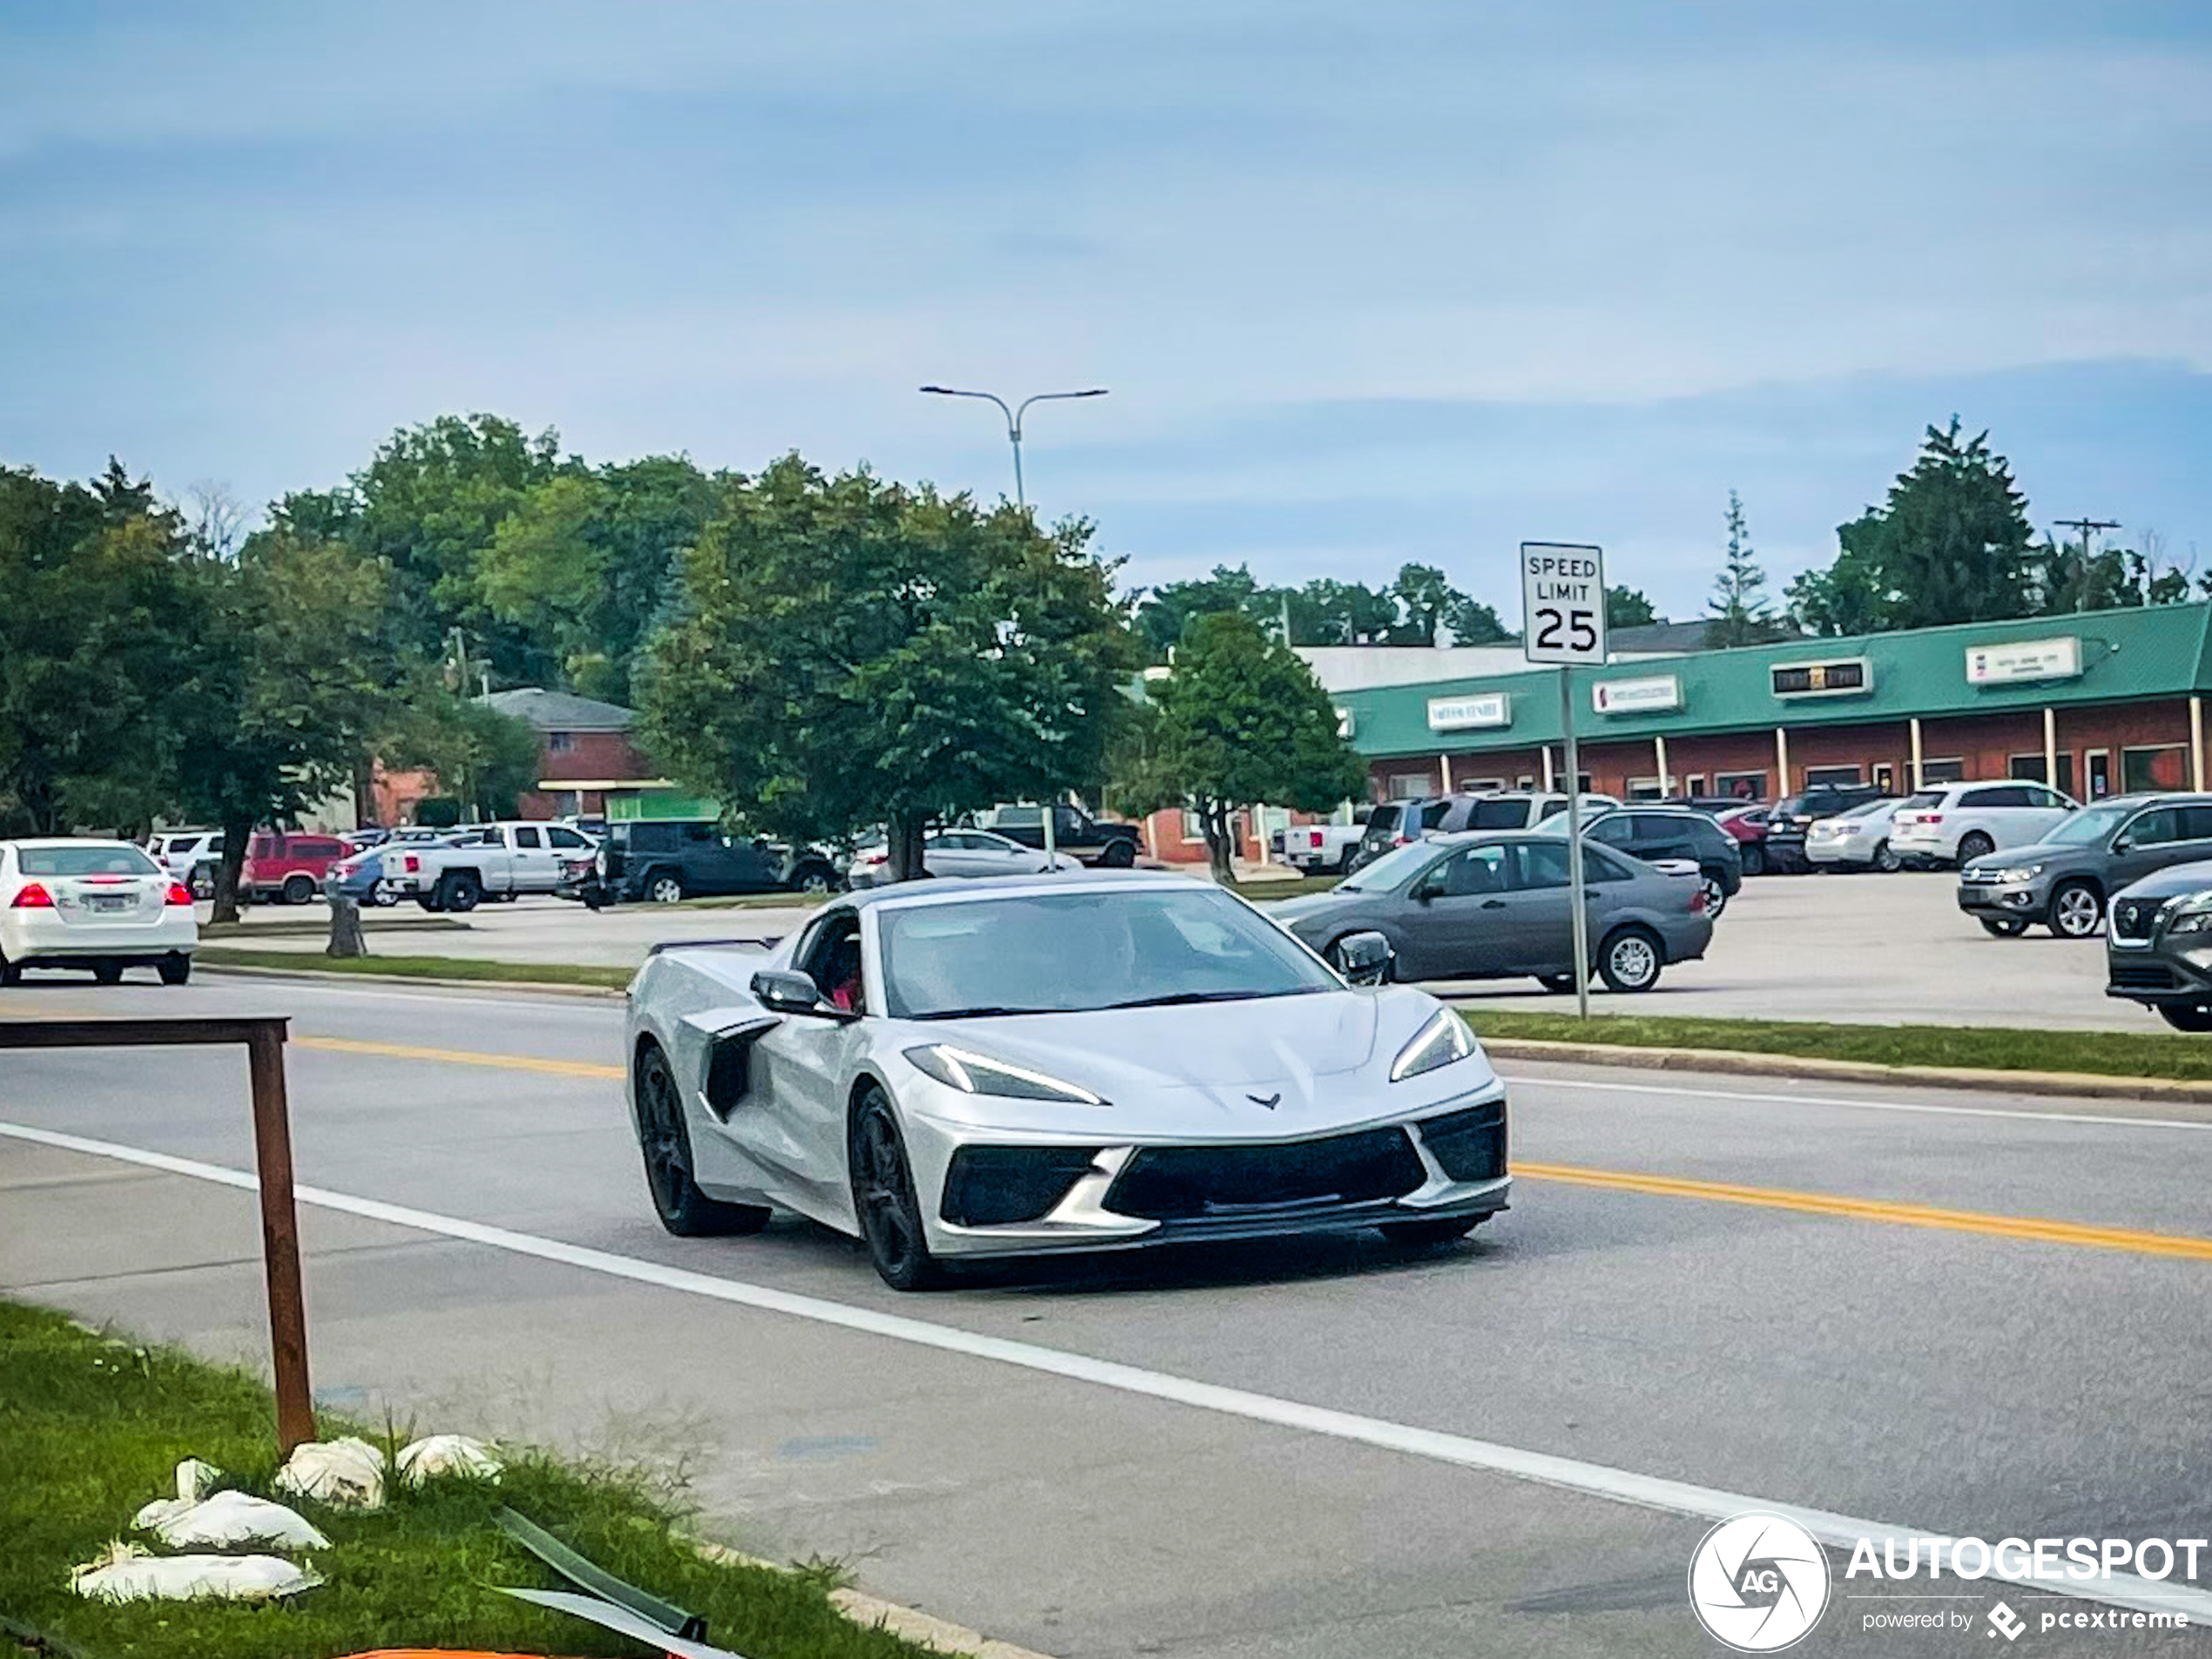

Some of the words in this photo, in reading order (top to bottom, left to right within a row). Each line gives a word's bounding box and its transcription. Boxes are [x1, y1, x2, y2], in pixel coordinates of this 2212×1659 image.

[1529, 557, 1596, 577] SPEED
[1537, 582, 1589, 602] LIMIT
[1535, 608, 1597, 651] 25
